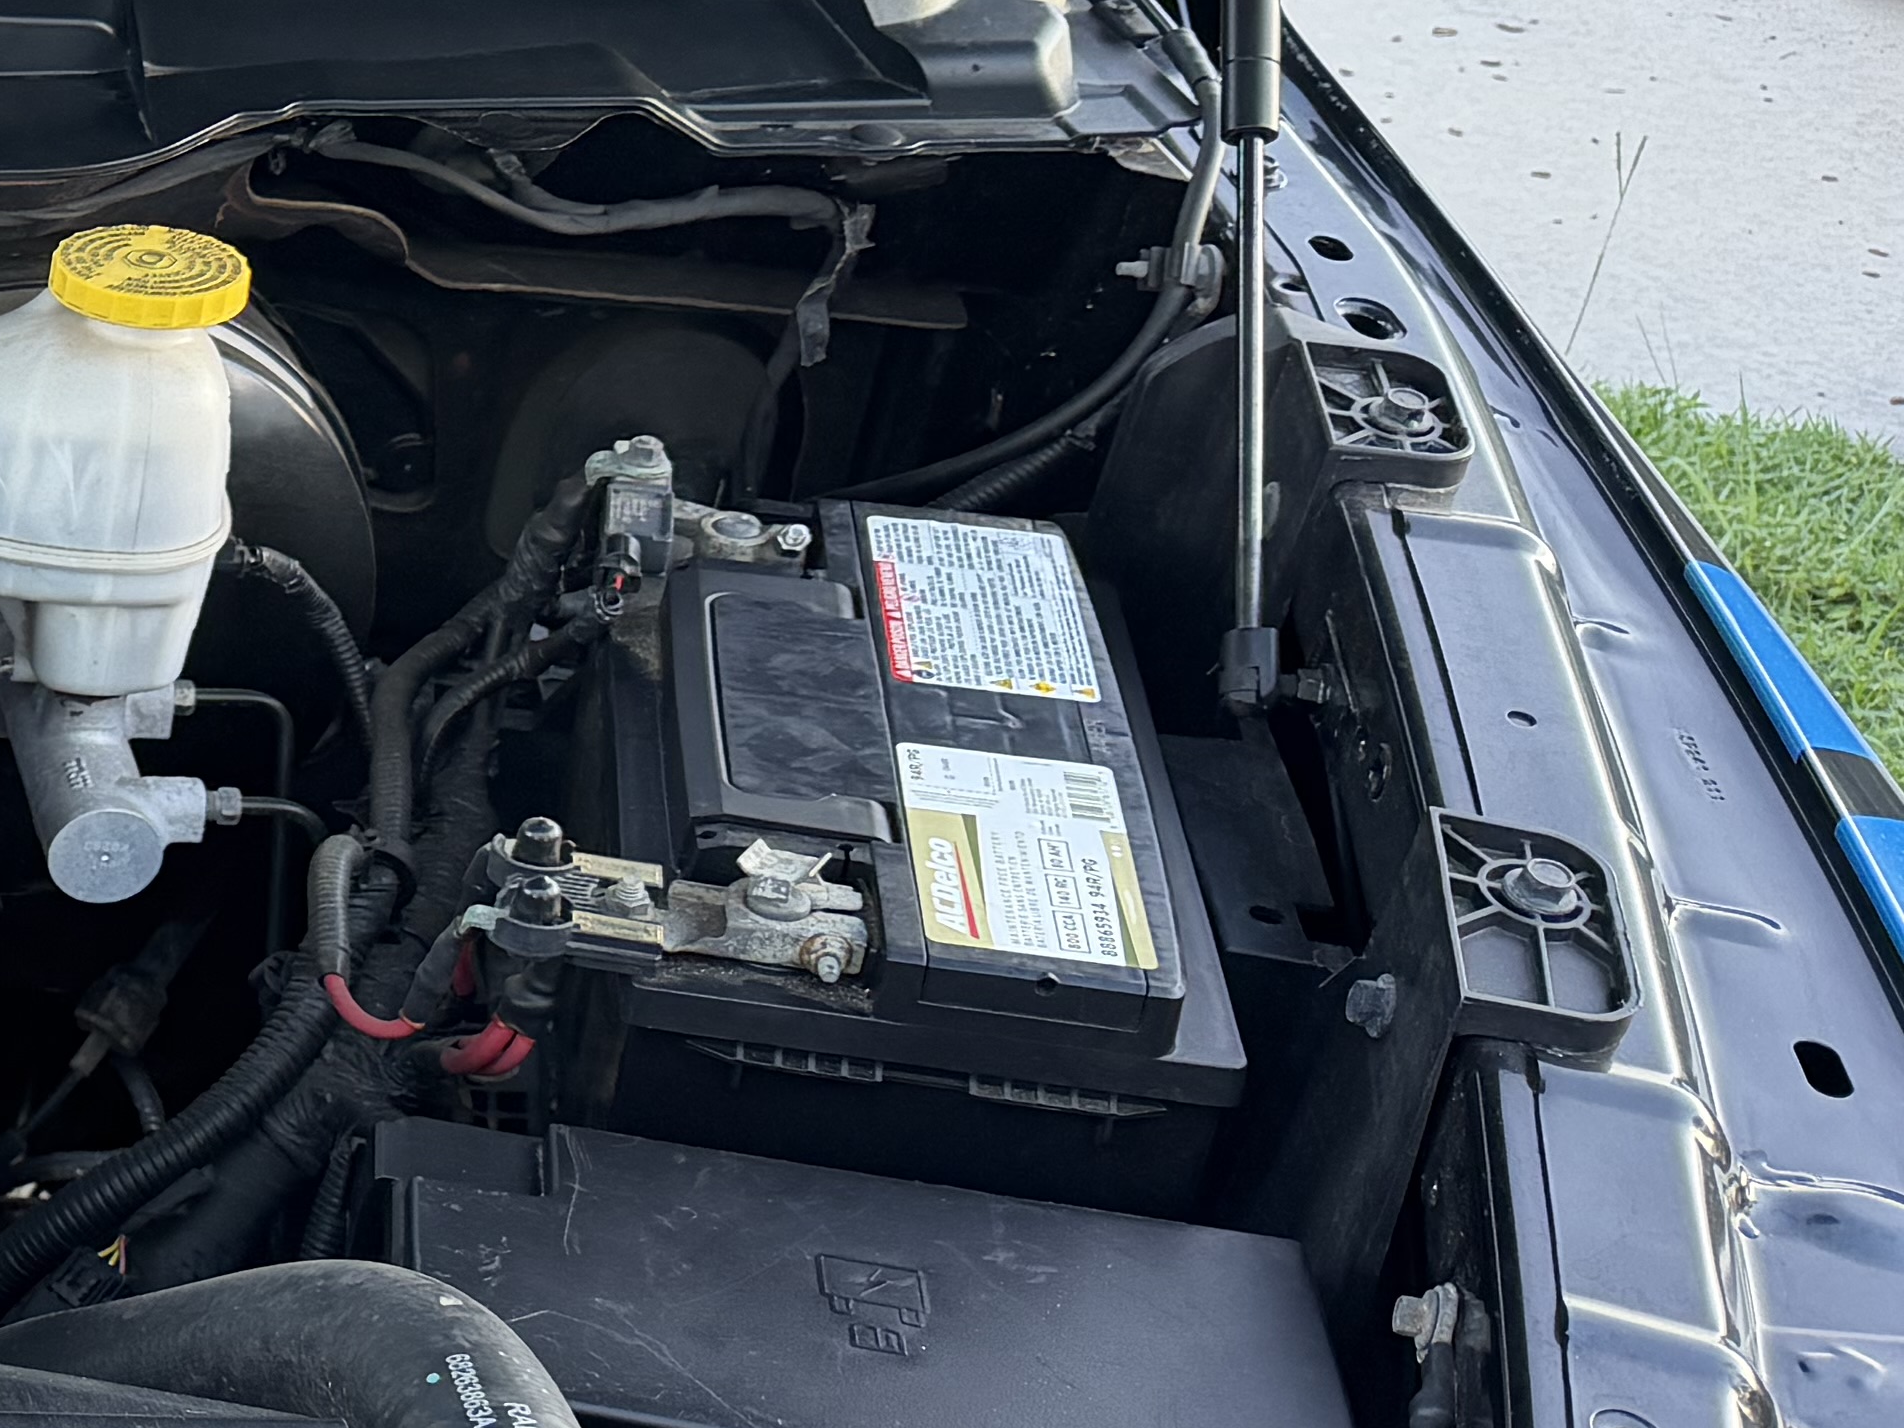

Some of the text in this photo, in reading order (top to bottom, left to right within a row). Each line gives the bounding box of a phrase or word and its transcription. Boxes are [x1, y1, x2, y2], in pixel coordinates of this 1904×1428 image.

[990, 831, 1006, 865] BATTERY
[923, 836, 968, 935] ACDelco
[1057, 890, 1073, 905] 140
[1080, 857, 1119, 958] 88865934 94R/PG
[1062, 914, 1082, 950] 800 CCA
